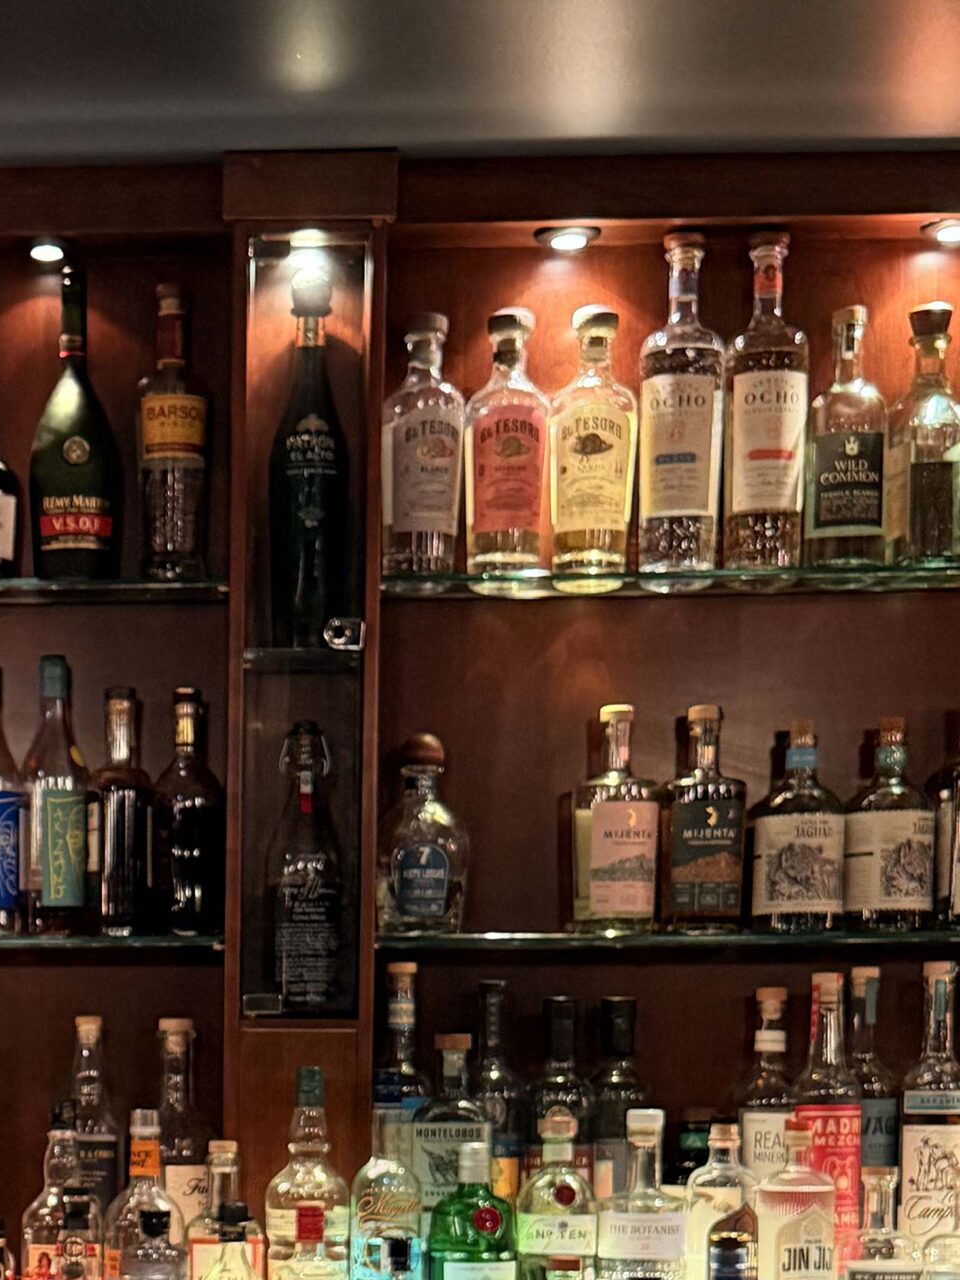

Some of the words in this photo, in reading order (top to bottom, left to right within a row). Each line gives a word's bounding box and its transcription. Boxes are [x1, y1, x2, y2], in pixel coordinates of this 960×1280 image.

[649, 394, 706, 411] OCHO
[743, 391, 799, 405] OCHO
[834, 459, 868, 472] WILD
[820, 471, 880, 486] COMMON
[603, 829, 652, 841] MIJENTA
[683, 827, 736, 839] MIJENTA
[418, 846, 431, 864] 7
[415, 1126, 482, 1139] MONTELOBOS
[630, 1224, 681, 1236] BOTANIST
[782, 1247, 810, 1273] JIN
